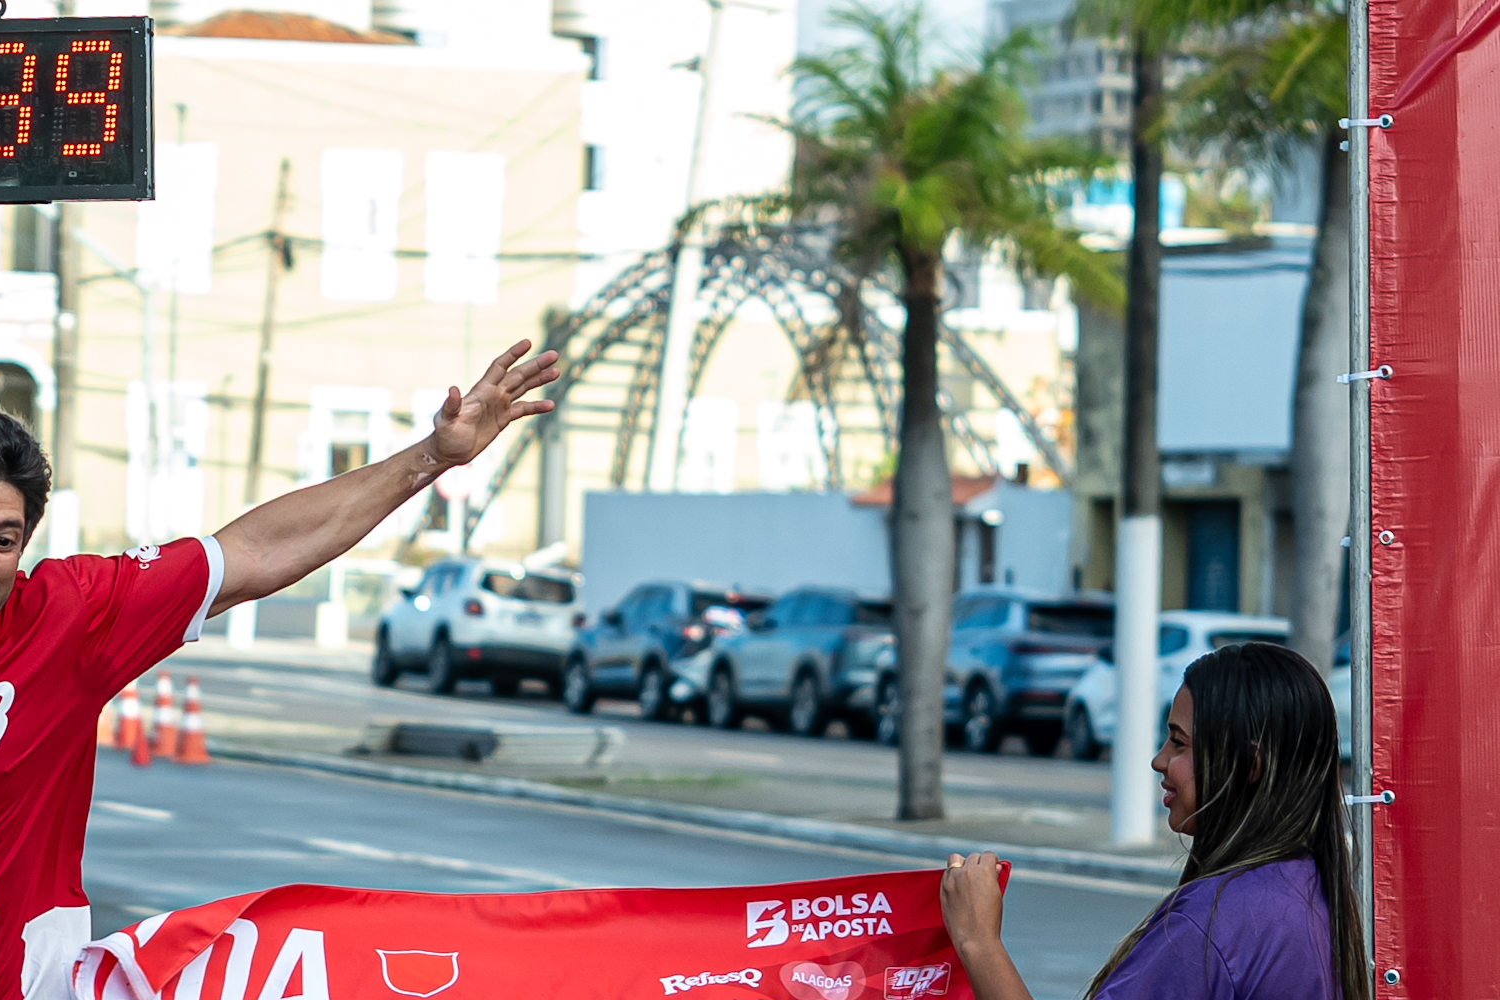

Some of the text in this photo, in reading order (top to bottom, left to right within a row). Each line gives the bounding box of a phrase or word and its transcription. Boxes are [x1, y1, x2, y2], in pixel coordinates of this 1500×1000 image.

[791, 892, 892, 920] BOLSA
[791, 917, 893, 942] DE APOSTA
[659, 968, 762, 995] RefresQ
[792, 972, 852, 989] ALAGOAS
[896, 967, 935, 987] 100
